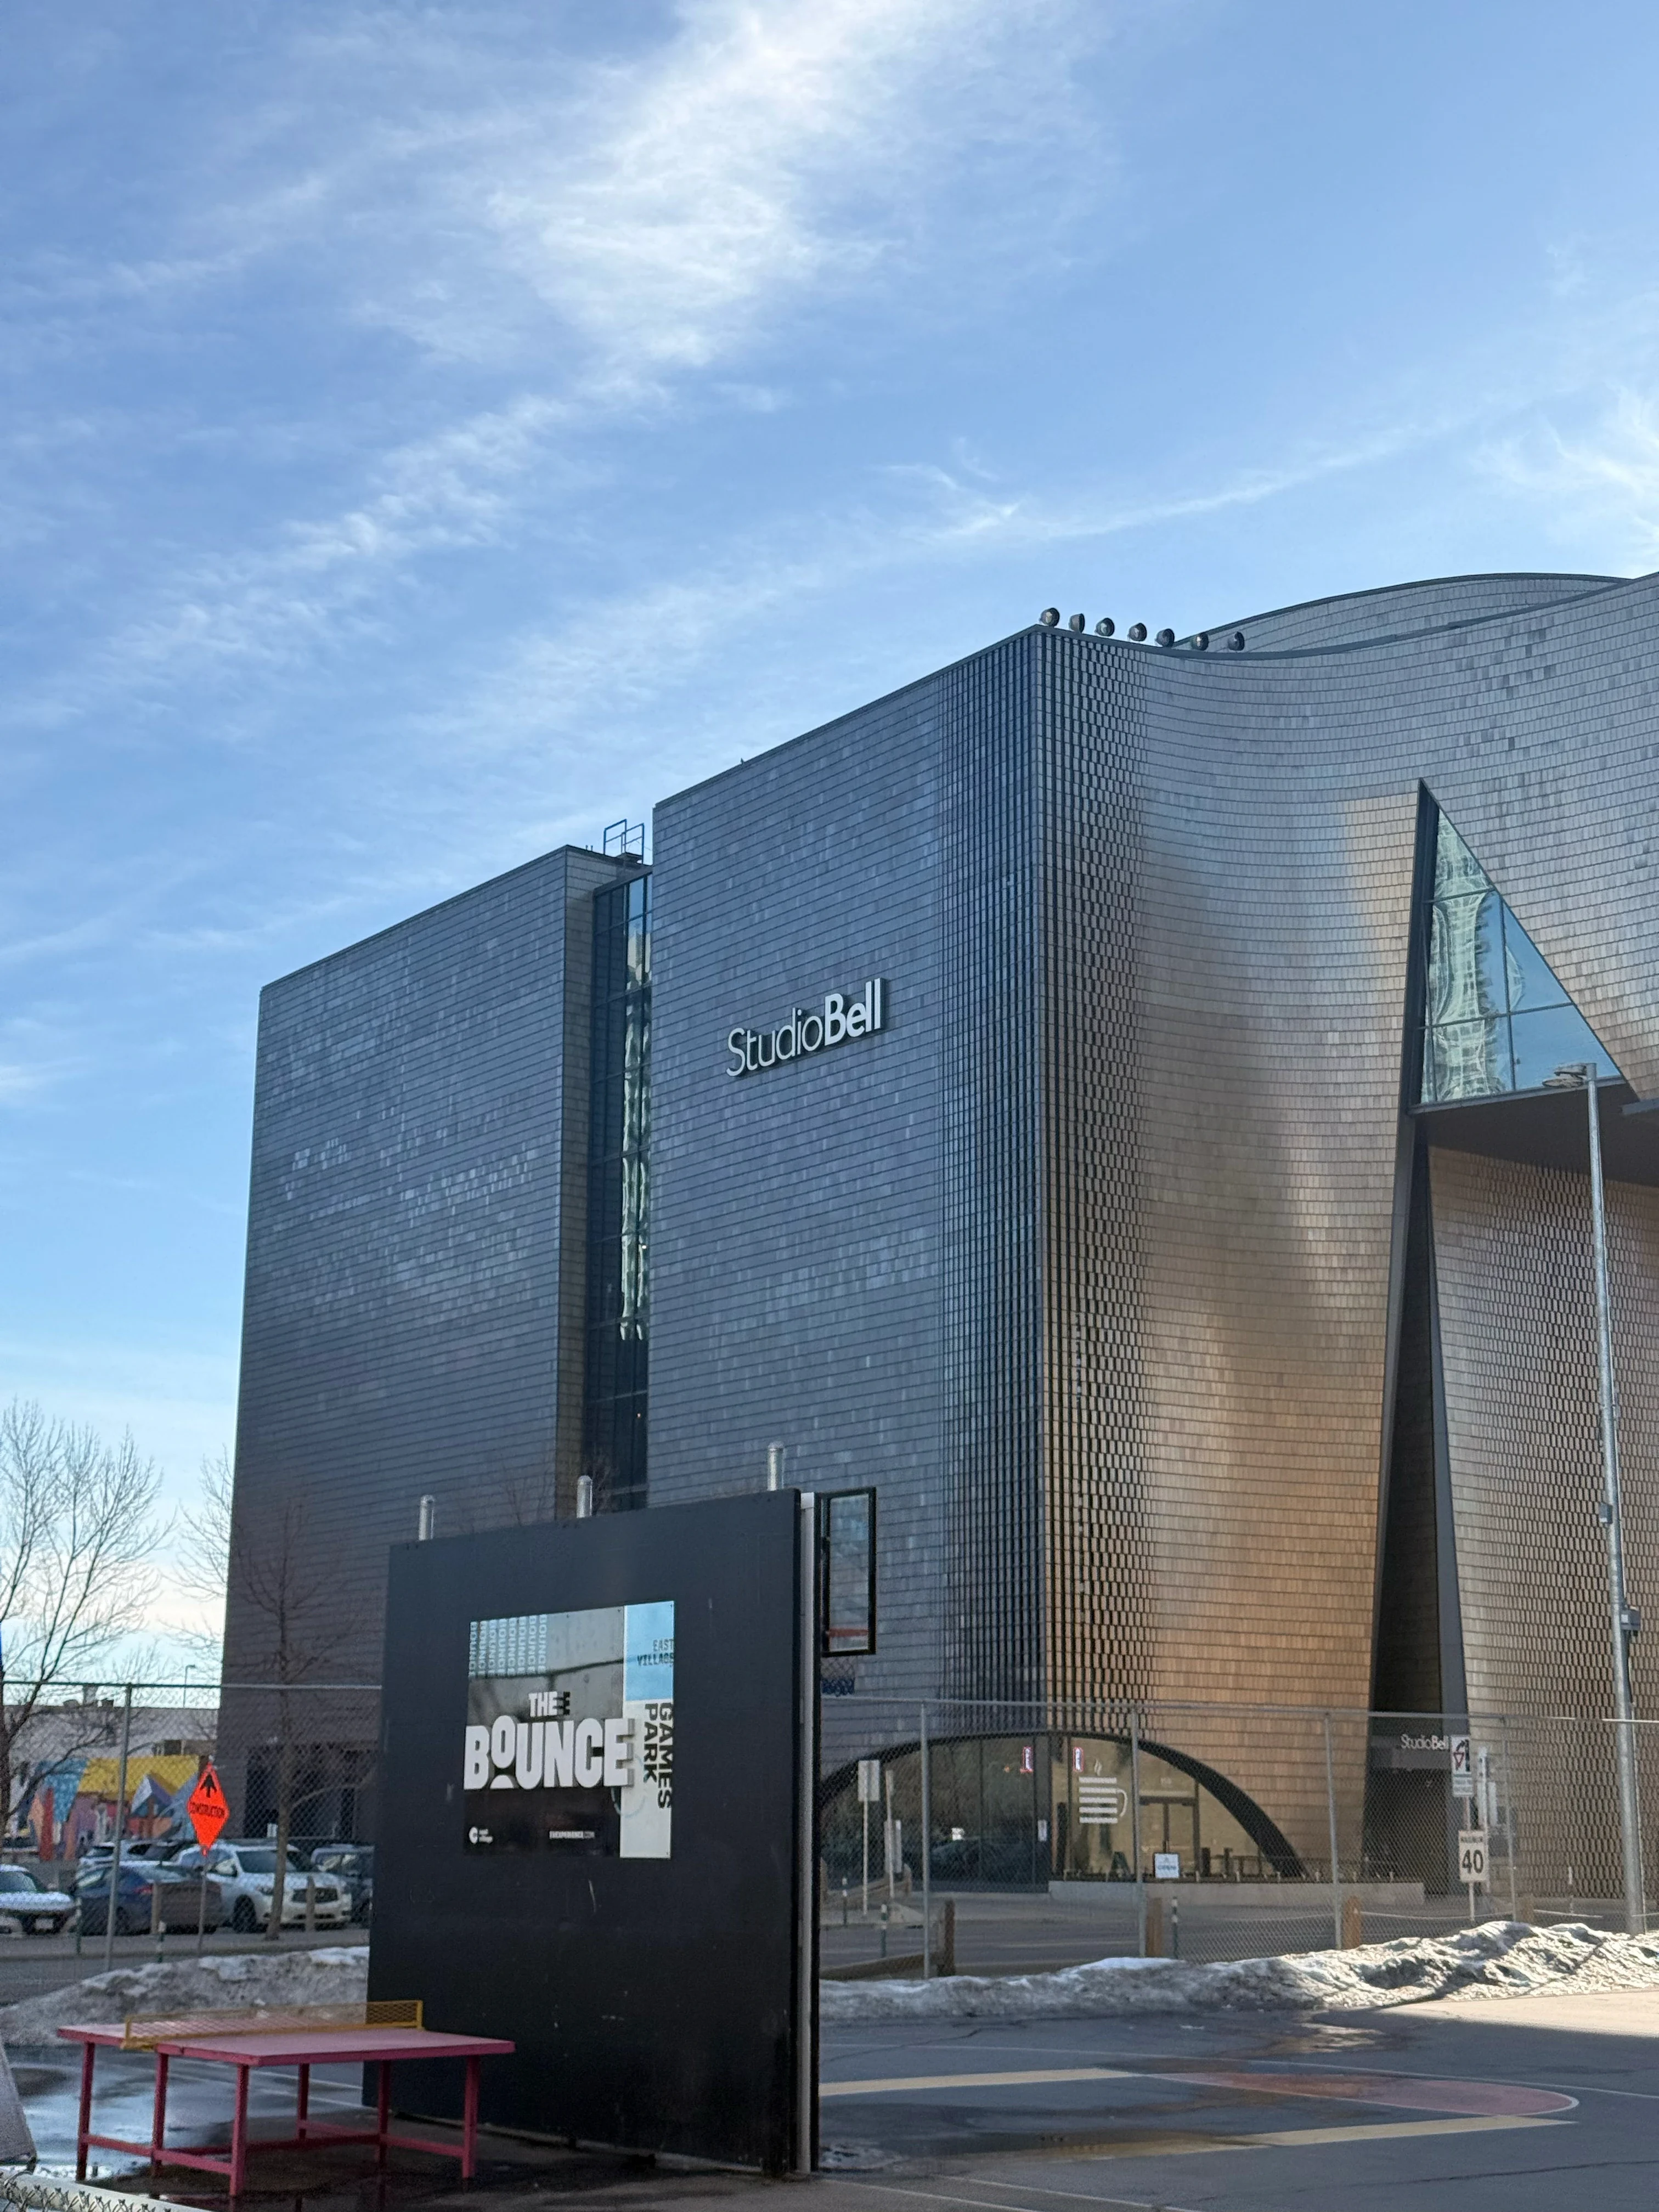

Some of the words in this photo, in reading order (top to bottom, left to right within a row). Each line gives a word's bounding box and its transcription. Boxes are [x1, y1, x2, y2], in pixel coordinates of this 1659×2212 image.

[653, 1638, 674, 1652] EAST
[637, 1652, 674, 1666] VILLAGE
[528, 1691, 557, 1717] THE
[464, 1715, 630, 1790] BOUNCE
[643, 1703, 658, 1782] PARK
[658, 1702, 674, 1808] GAMES
[189, 1801, 225, 1819] CONSTRUCTION
[1462, 1849, 1483, 1874] 40
